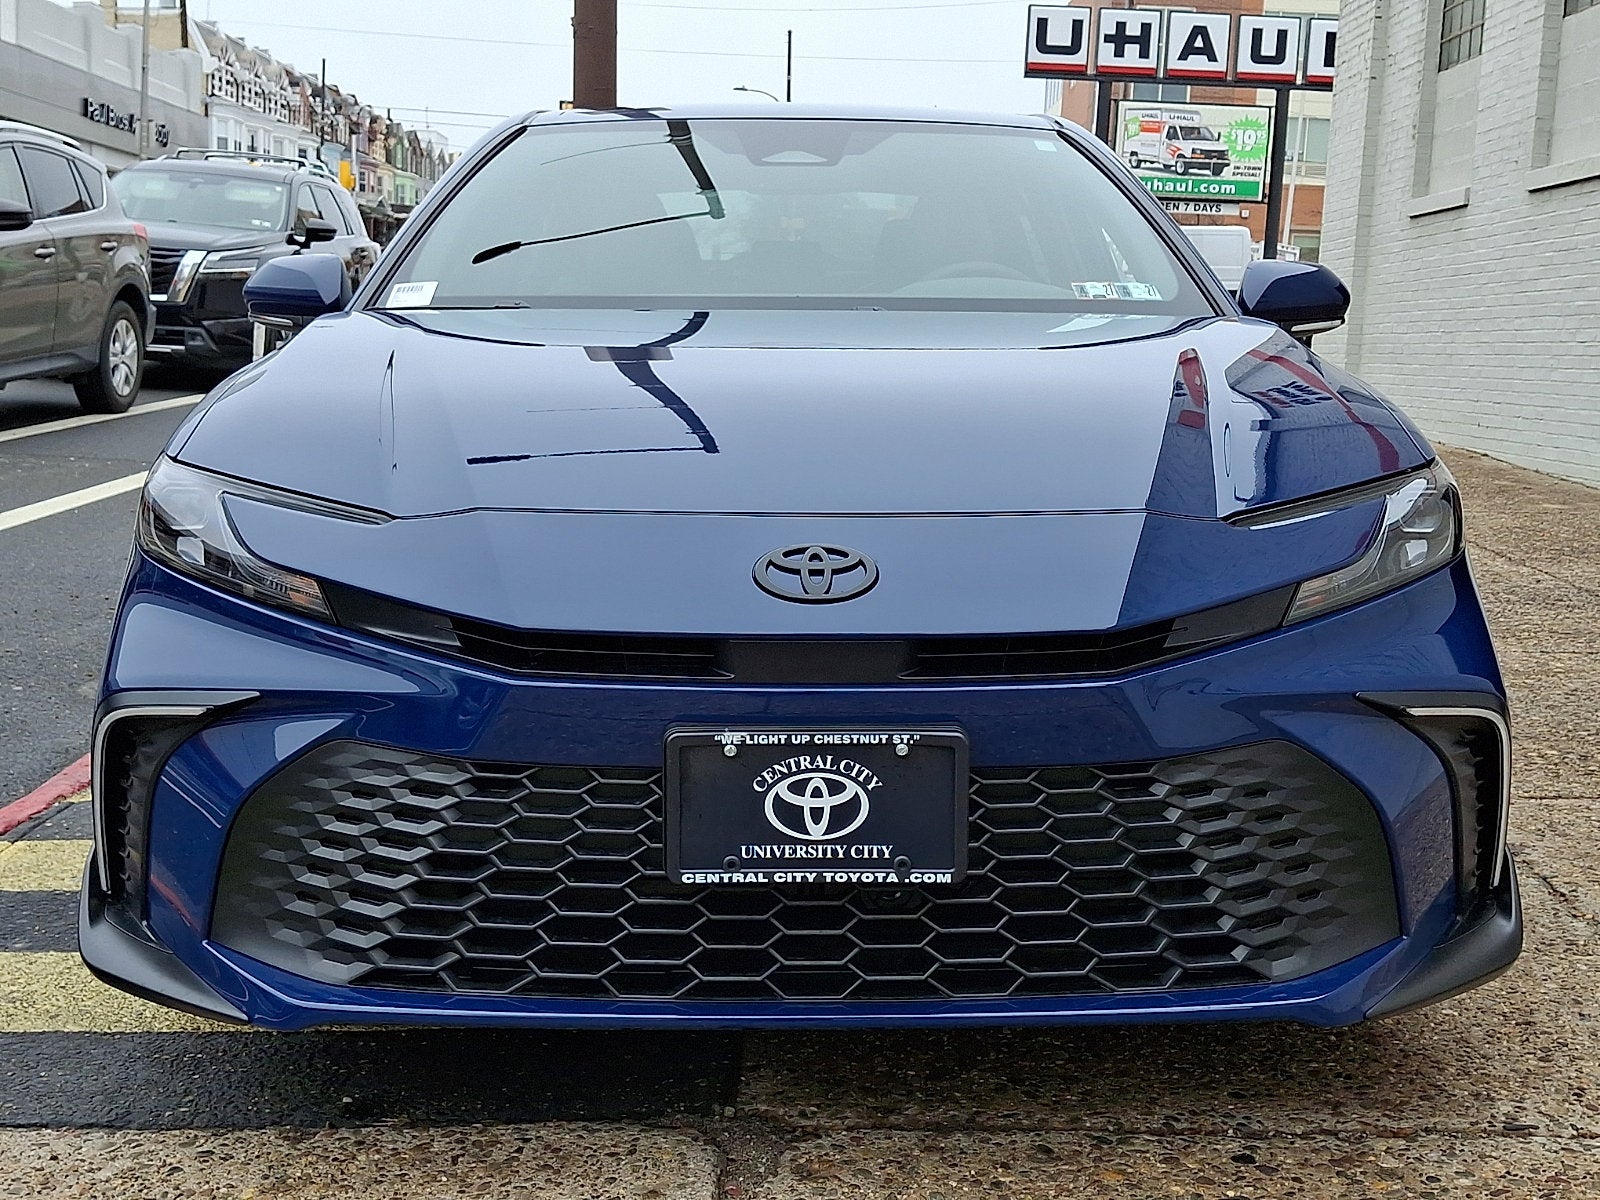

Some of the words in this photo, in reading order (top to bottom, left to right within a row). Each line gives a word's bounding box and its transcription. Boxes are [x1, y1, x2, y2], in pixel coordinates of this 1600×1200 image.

[1184, 202, 1191, 212] 7
[1193, 203, 1222, 213] DAYS
[746, 734, 788, 745] LIGHT
[791, 734, 811, 745] UP
[813, 734, 889, 745] CHESTNUT
[752, 755, 838, 793] CENTRAL
[838, 758, 884, 792] CITY
[740, 844, 847, 859] UNIVERSITY
[850, 844, 894, 859] CITY
[681, 872, 769, 884] CENTRAL
[773, 872, 818, 884] CITY
[822, 872, 899, 884] TOYOTA
[903, 872, 952, 884] .COM
